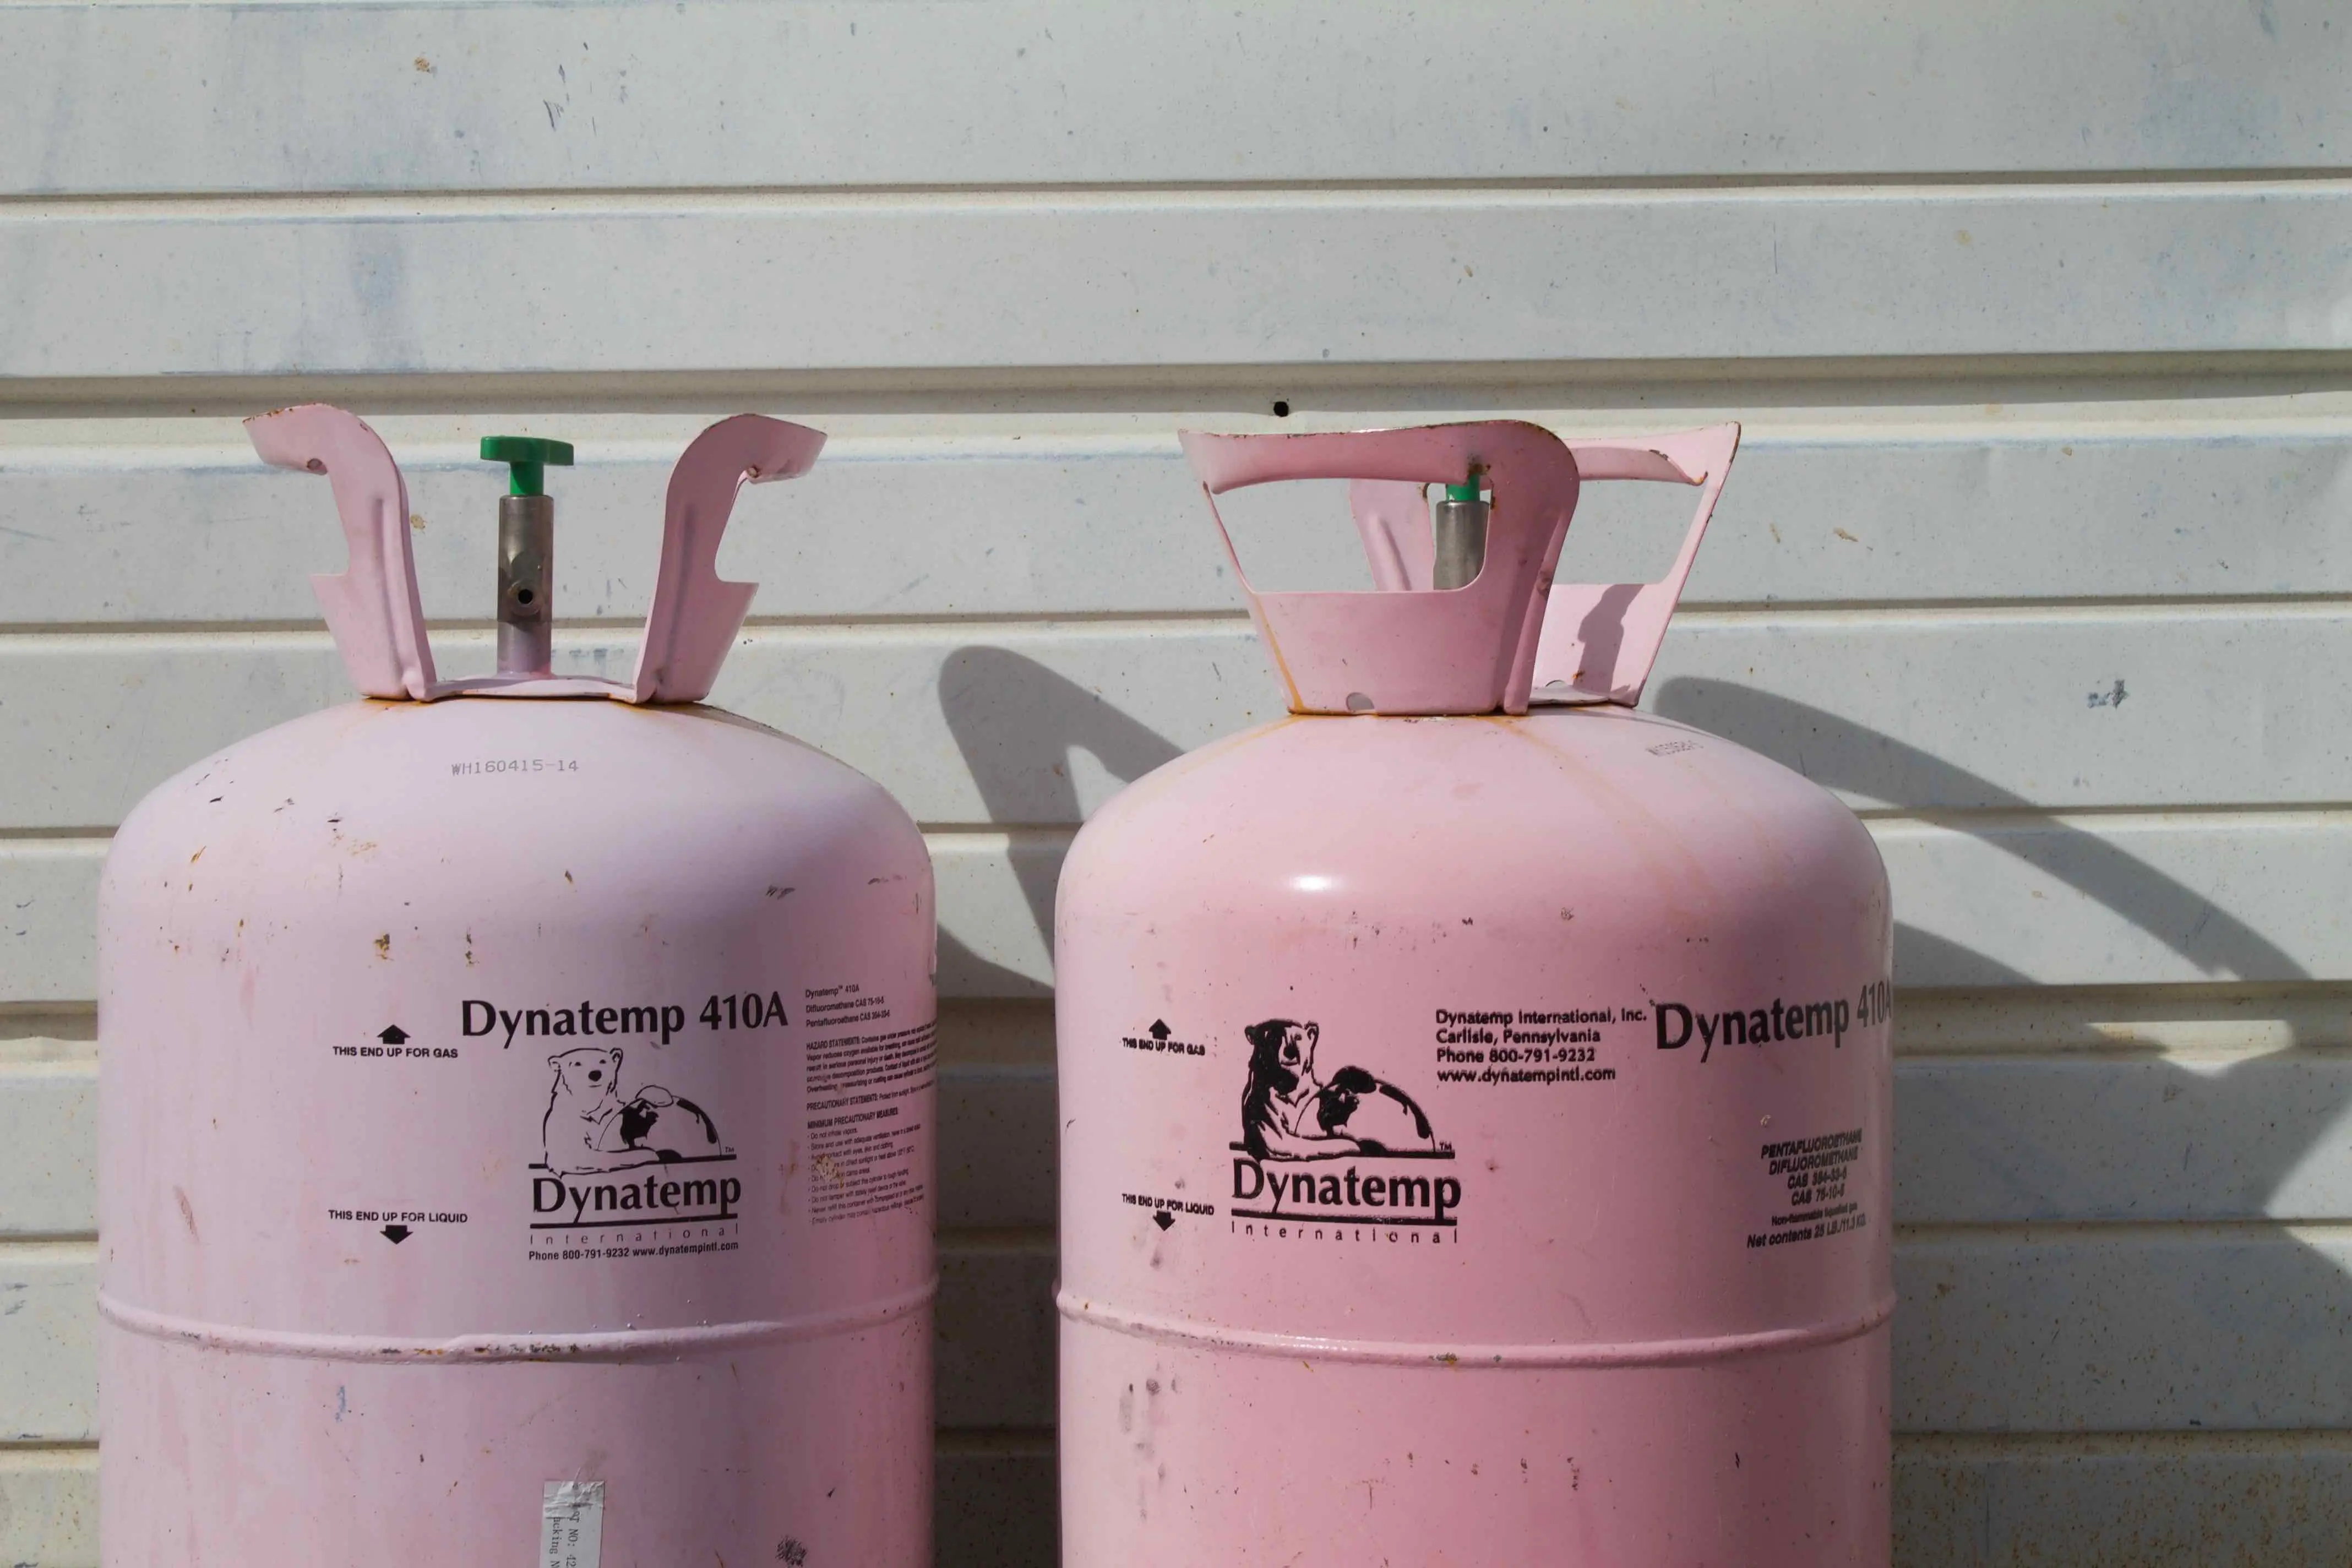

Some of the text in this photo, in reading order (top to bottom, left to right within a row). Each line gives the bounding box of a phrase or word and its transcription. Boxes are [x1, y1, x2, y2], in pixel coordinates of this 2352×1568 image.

[451, 759, 579, 776] WH160415-14
[845, 983, 859, 993] 410A
[855, 997, 866, 1008] CAS
[462, 991, 789, 1049] Dynatemp 410A
[859, 1011, 870, 1021] CAS
[1436, 1006, 1647, 1027] Dynatemp International, Inc.
[1656, 977, 1892, 1063] Dynatemp 410A
[806, 1041, 827, 1050] HAZARD
[1436, 1027, 1600, 1046] Carlisle, Pennsylvania
[333, 1046, 458, 1058] THIS END UP FOR GAS
[1122, 1038, 1205, 1056] THIS END UP FOR GAS
[1436, 1046, 1594, 1063] Phone 800-791-9232
[1438, 1067, 1616, 1085] www.dynatempintl.com
[834, 1112, 874, 1126] PRECAUTIONARY
[1232, 1158, 1461, 1219] Dynatemp
[1788, 1173, 1809, 1189] CAS
[532, 1175, 741, 1224] Dynatemp
[1122, 1194, 1215, 1216] THIS END UP FOR LIQUID
[1791, 1190, 1812, 1206] CAS
[328, 1210, 468, 1223] THIS END UP FOR LIQUID
[530, 1223, 739, 1246] International
[1231, 1223, 1458, 1244] International
[1747, 1234, 1767, 1248] Net
[1769, 1228, 1812, 1245] contents
[1815, 1226, 1825, 1238] 25
[529, 1242, 739, 1260] Phone 800-791-9232 www.dynatempintl.com
[568, 1528, 579, 1547] NO:
[566, 1554, 577, 1568] 42
